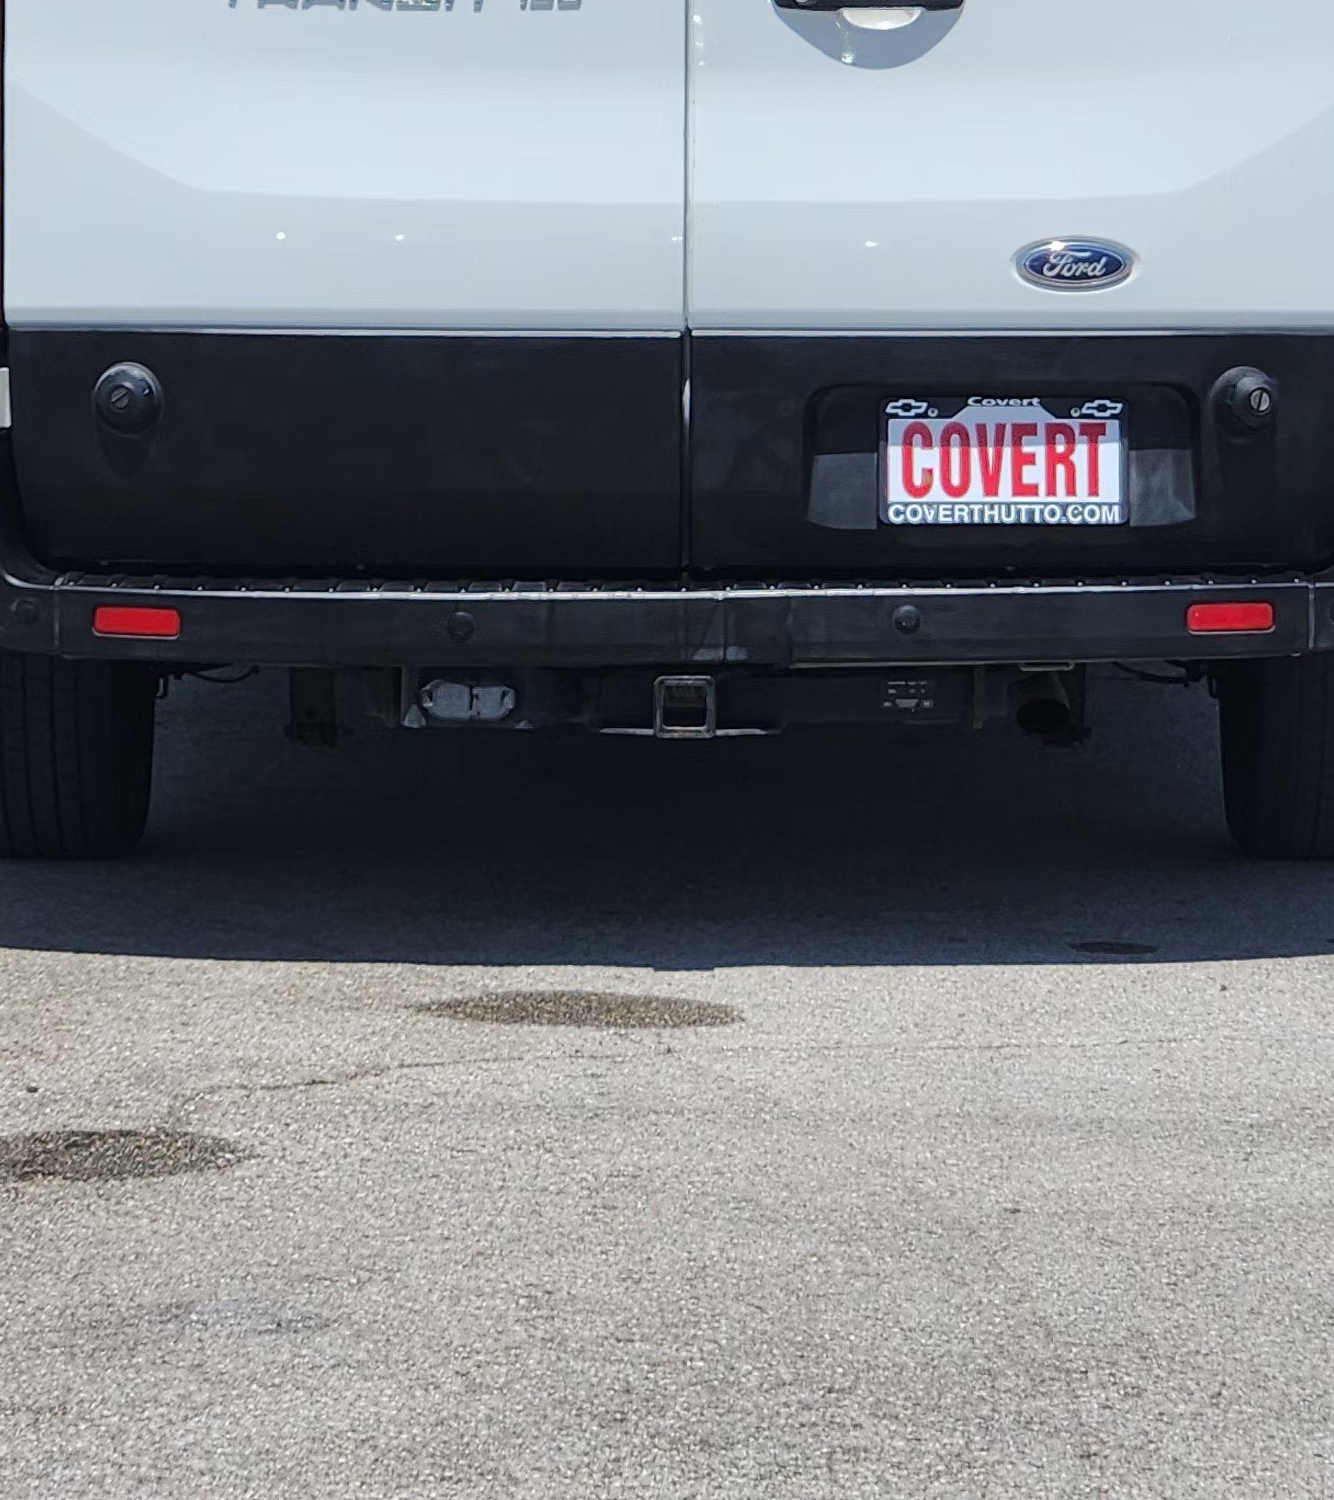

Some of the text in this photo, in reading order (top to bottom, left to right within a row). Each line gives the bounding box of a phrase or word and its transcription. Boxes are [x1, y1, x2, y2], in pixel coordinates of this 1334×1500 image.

[1042, 249, 1109, 278] Ford
[967, 396, 1042, 408] Covert
[901, 420, 1108, 499] COVERT
[887, 503, 1120, 525] COVERTHUTTO.COM
